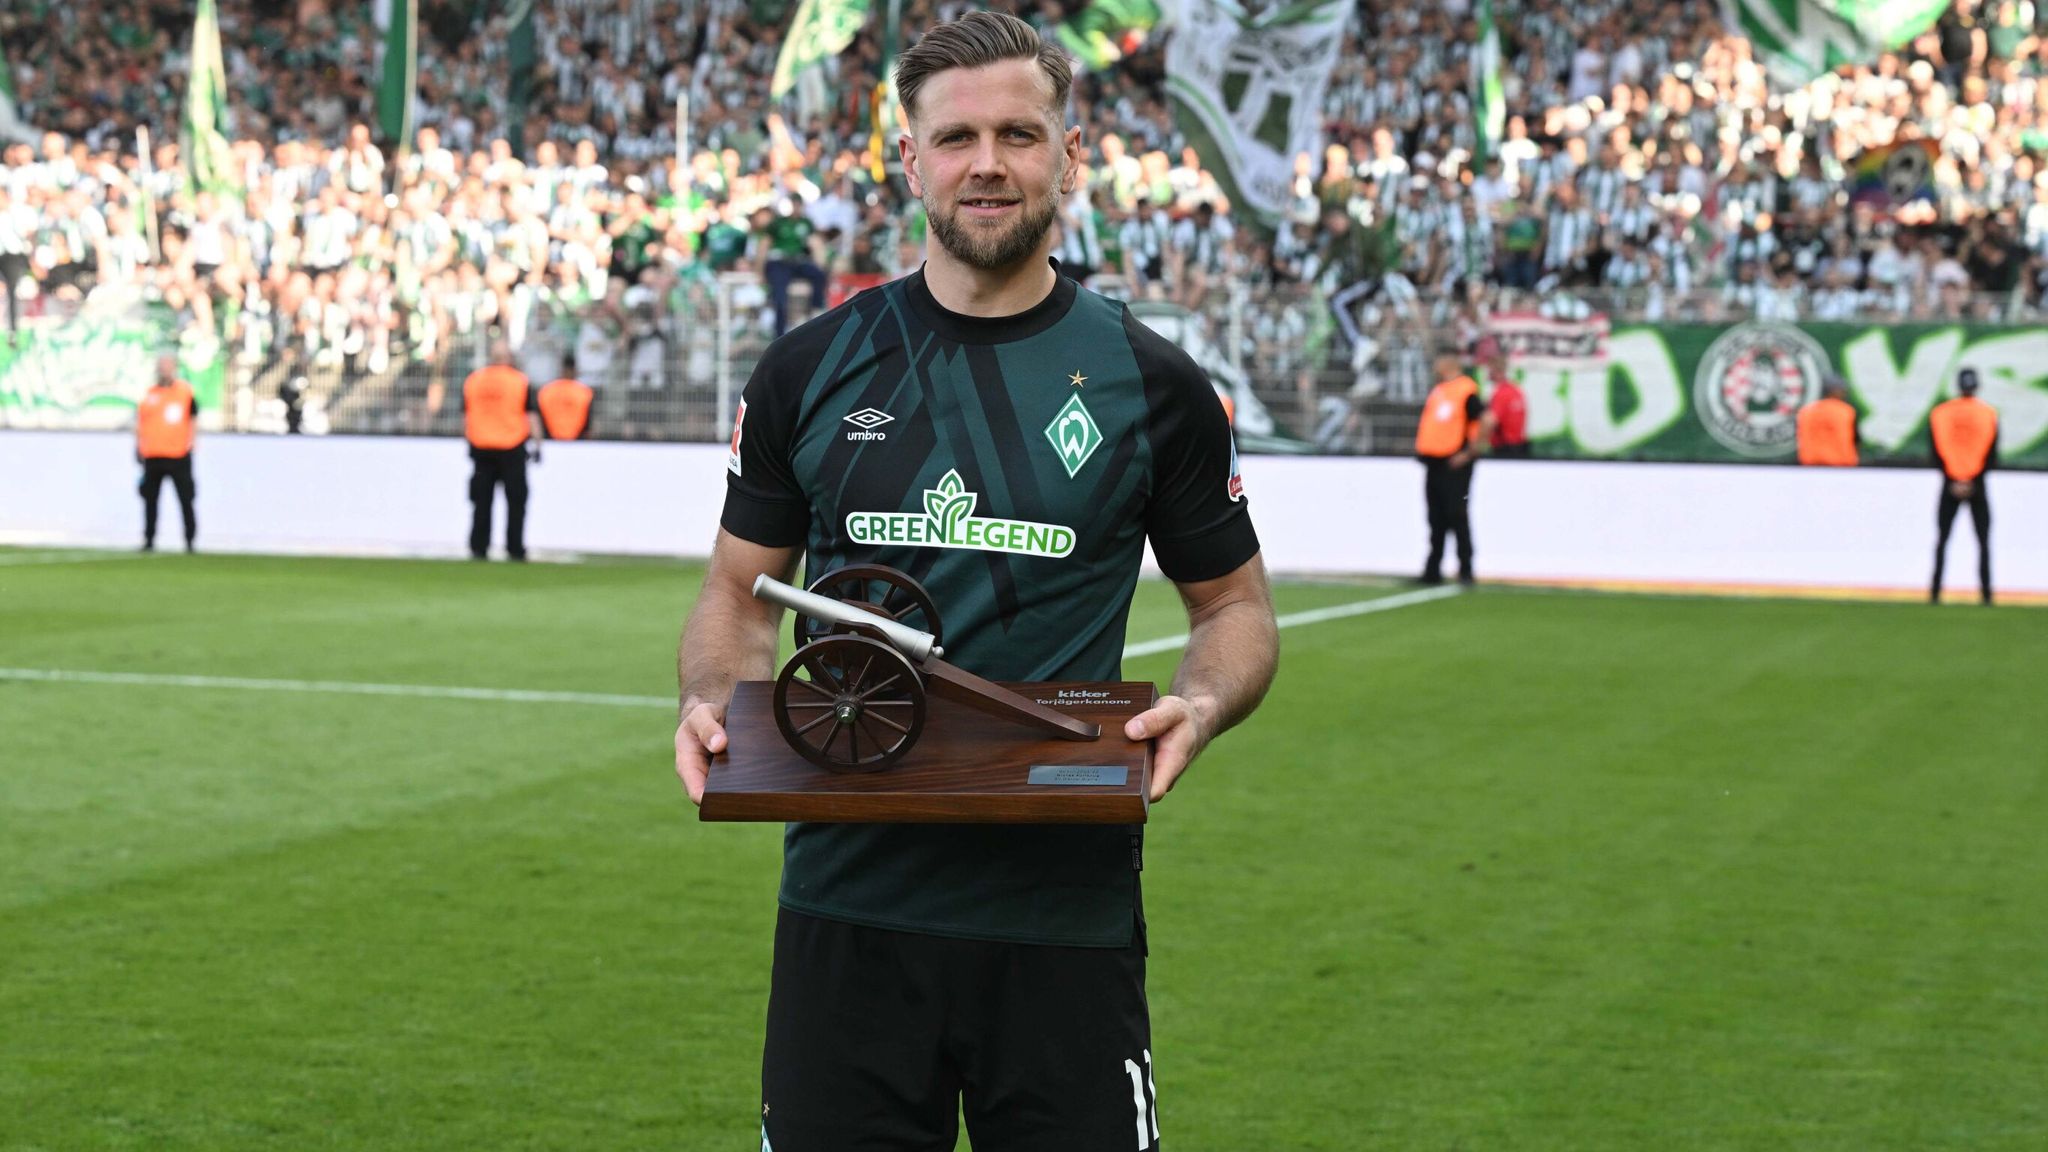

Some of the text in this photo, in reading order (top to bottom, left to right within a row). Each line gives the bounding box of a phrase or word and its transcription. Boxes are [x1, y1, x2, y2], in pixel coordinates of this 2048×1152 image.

[847, 430, 886, 441] umbro
[849, 515, 1073, 555] GREENLEGEND
[1058, 690, 1110, 698] kicker
[1035, 698, 1132, 706] Torjägerkanone
[1124, 1048, 1160, 1151] 11
